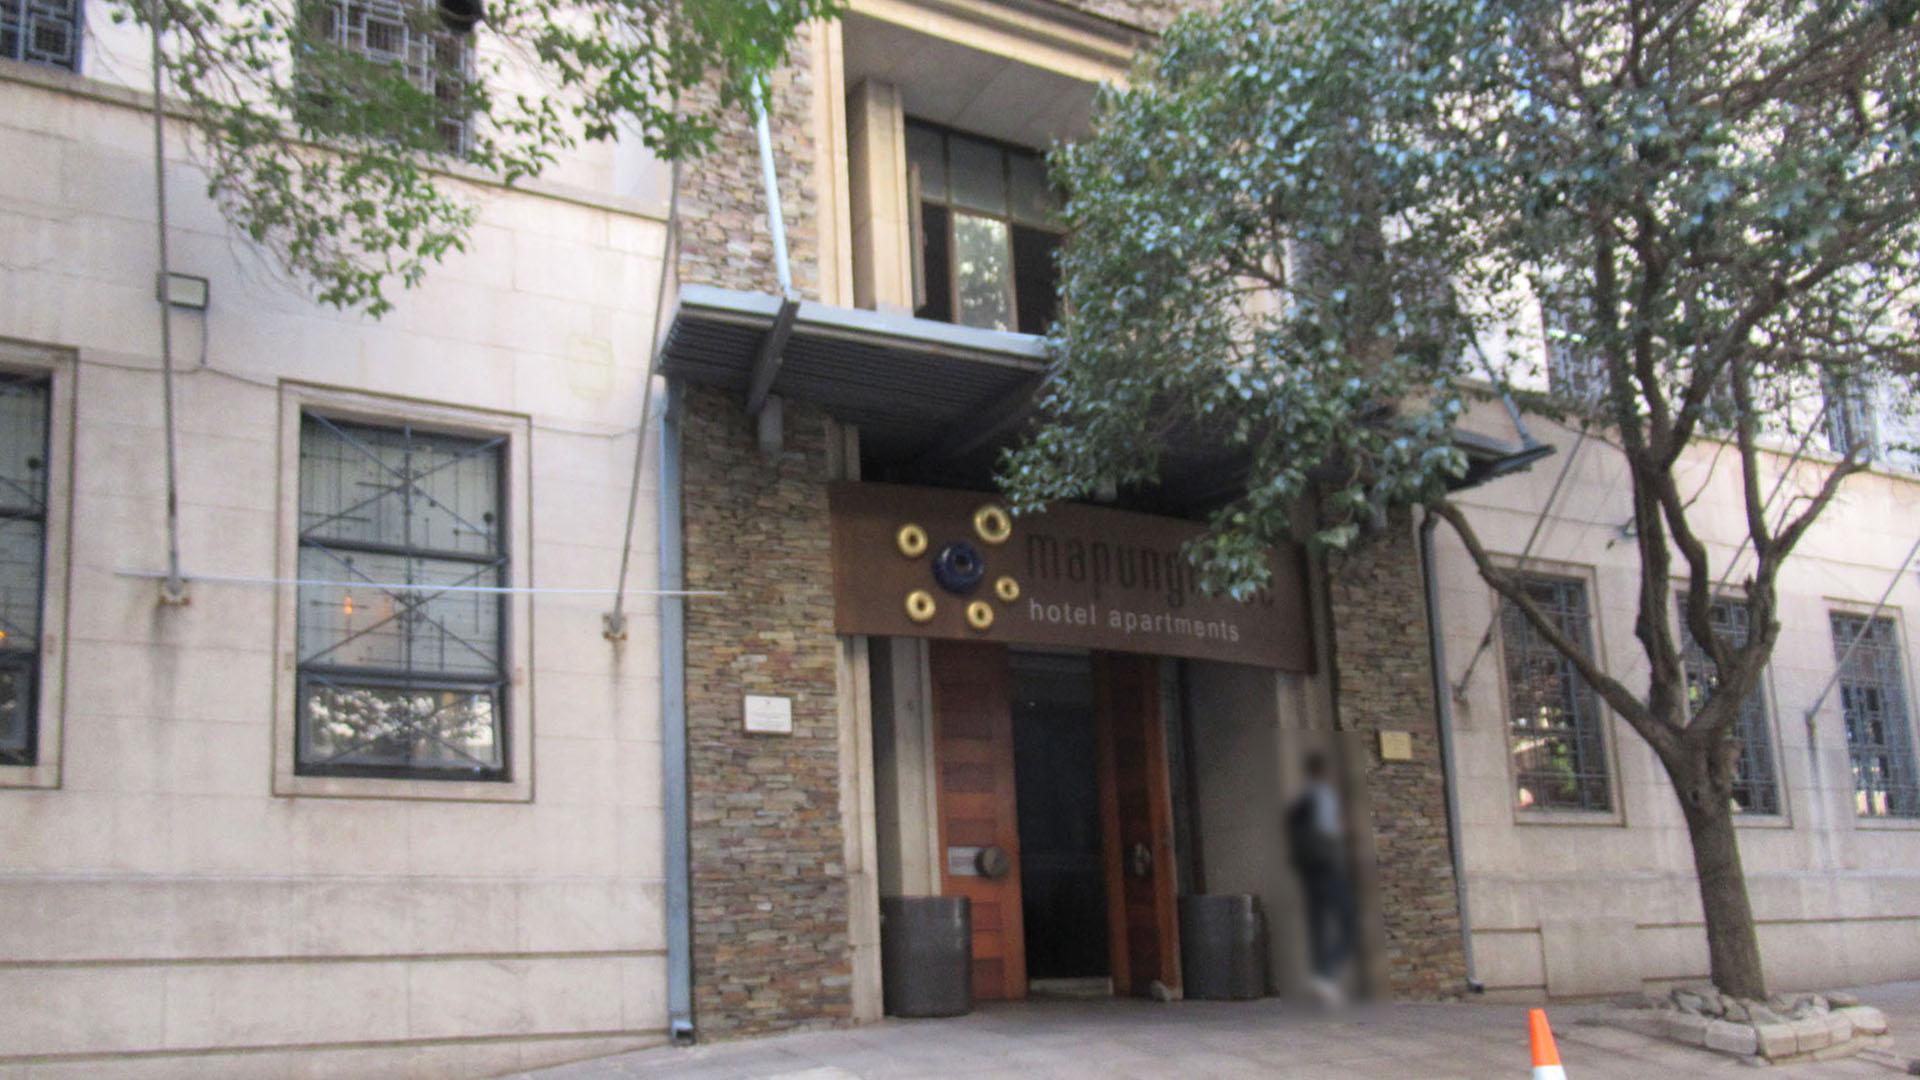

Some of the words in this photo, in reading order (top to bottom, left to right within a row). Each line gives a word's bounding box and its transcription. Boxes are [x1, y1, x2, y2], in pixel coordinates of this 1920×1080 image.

[1027, 534, 1274, 607] mapung
[1030, 599, 1096, 625] hotel
[1110, 609, 1240, 642] apartments
